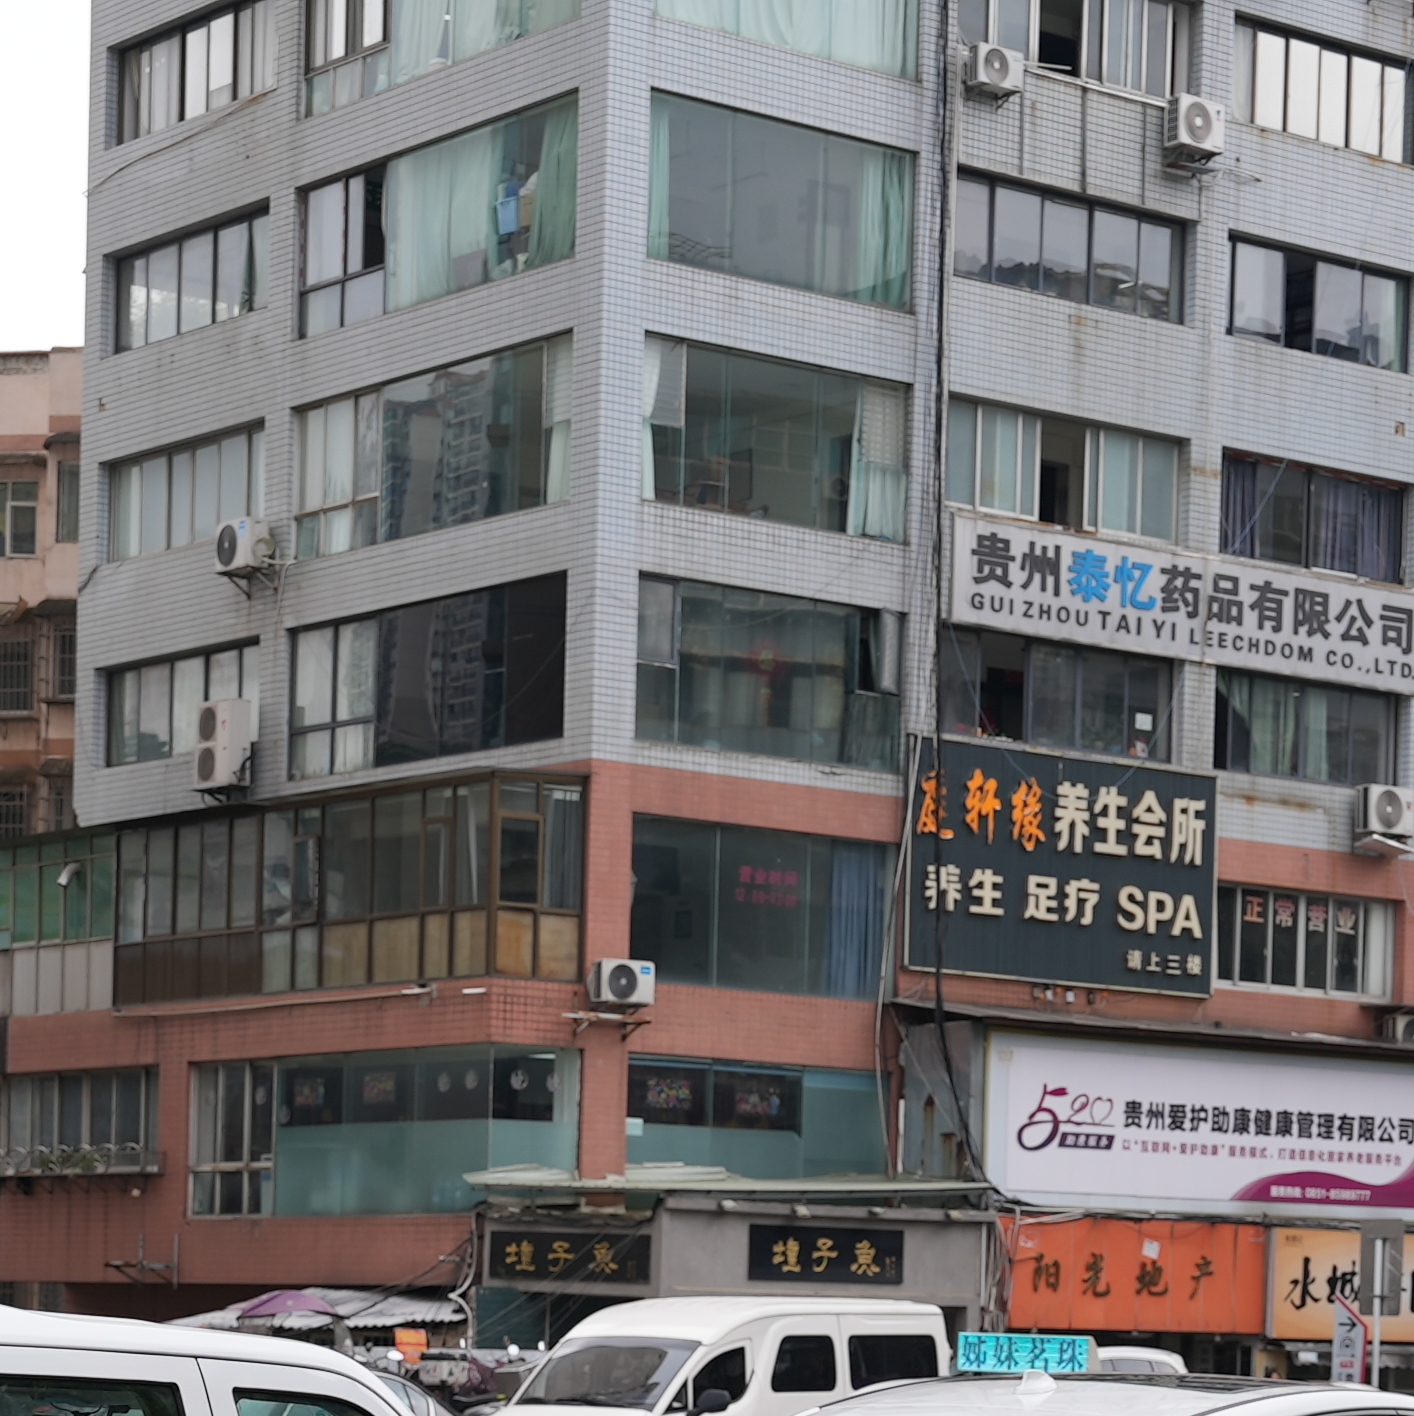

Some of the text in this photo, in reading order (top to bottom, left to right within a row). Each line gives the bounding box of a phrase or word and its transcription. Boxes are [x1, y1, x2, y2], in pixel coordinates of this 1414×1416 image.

[970, 531, 1414, 656] 贵州泰忆药品有限公司
[1188, 629, 1315, 665] LEECHDOM
[924, 864, 1204, 940] 养生 足疗 SPA
[1243, 894, 1357, 936] 正常营业
[1123, 1099, 1414, 1146] 贵州爱护助康健康管理有限公司
[1032, 1252, 1215, 1301] 阳光地产
